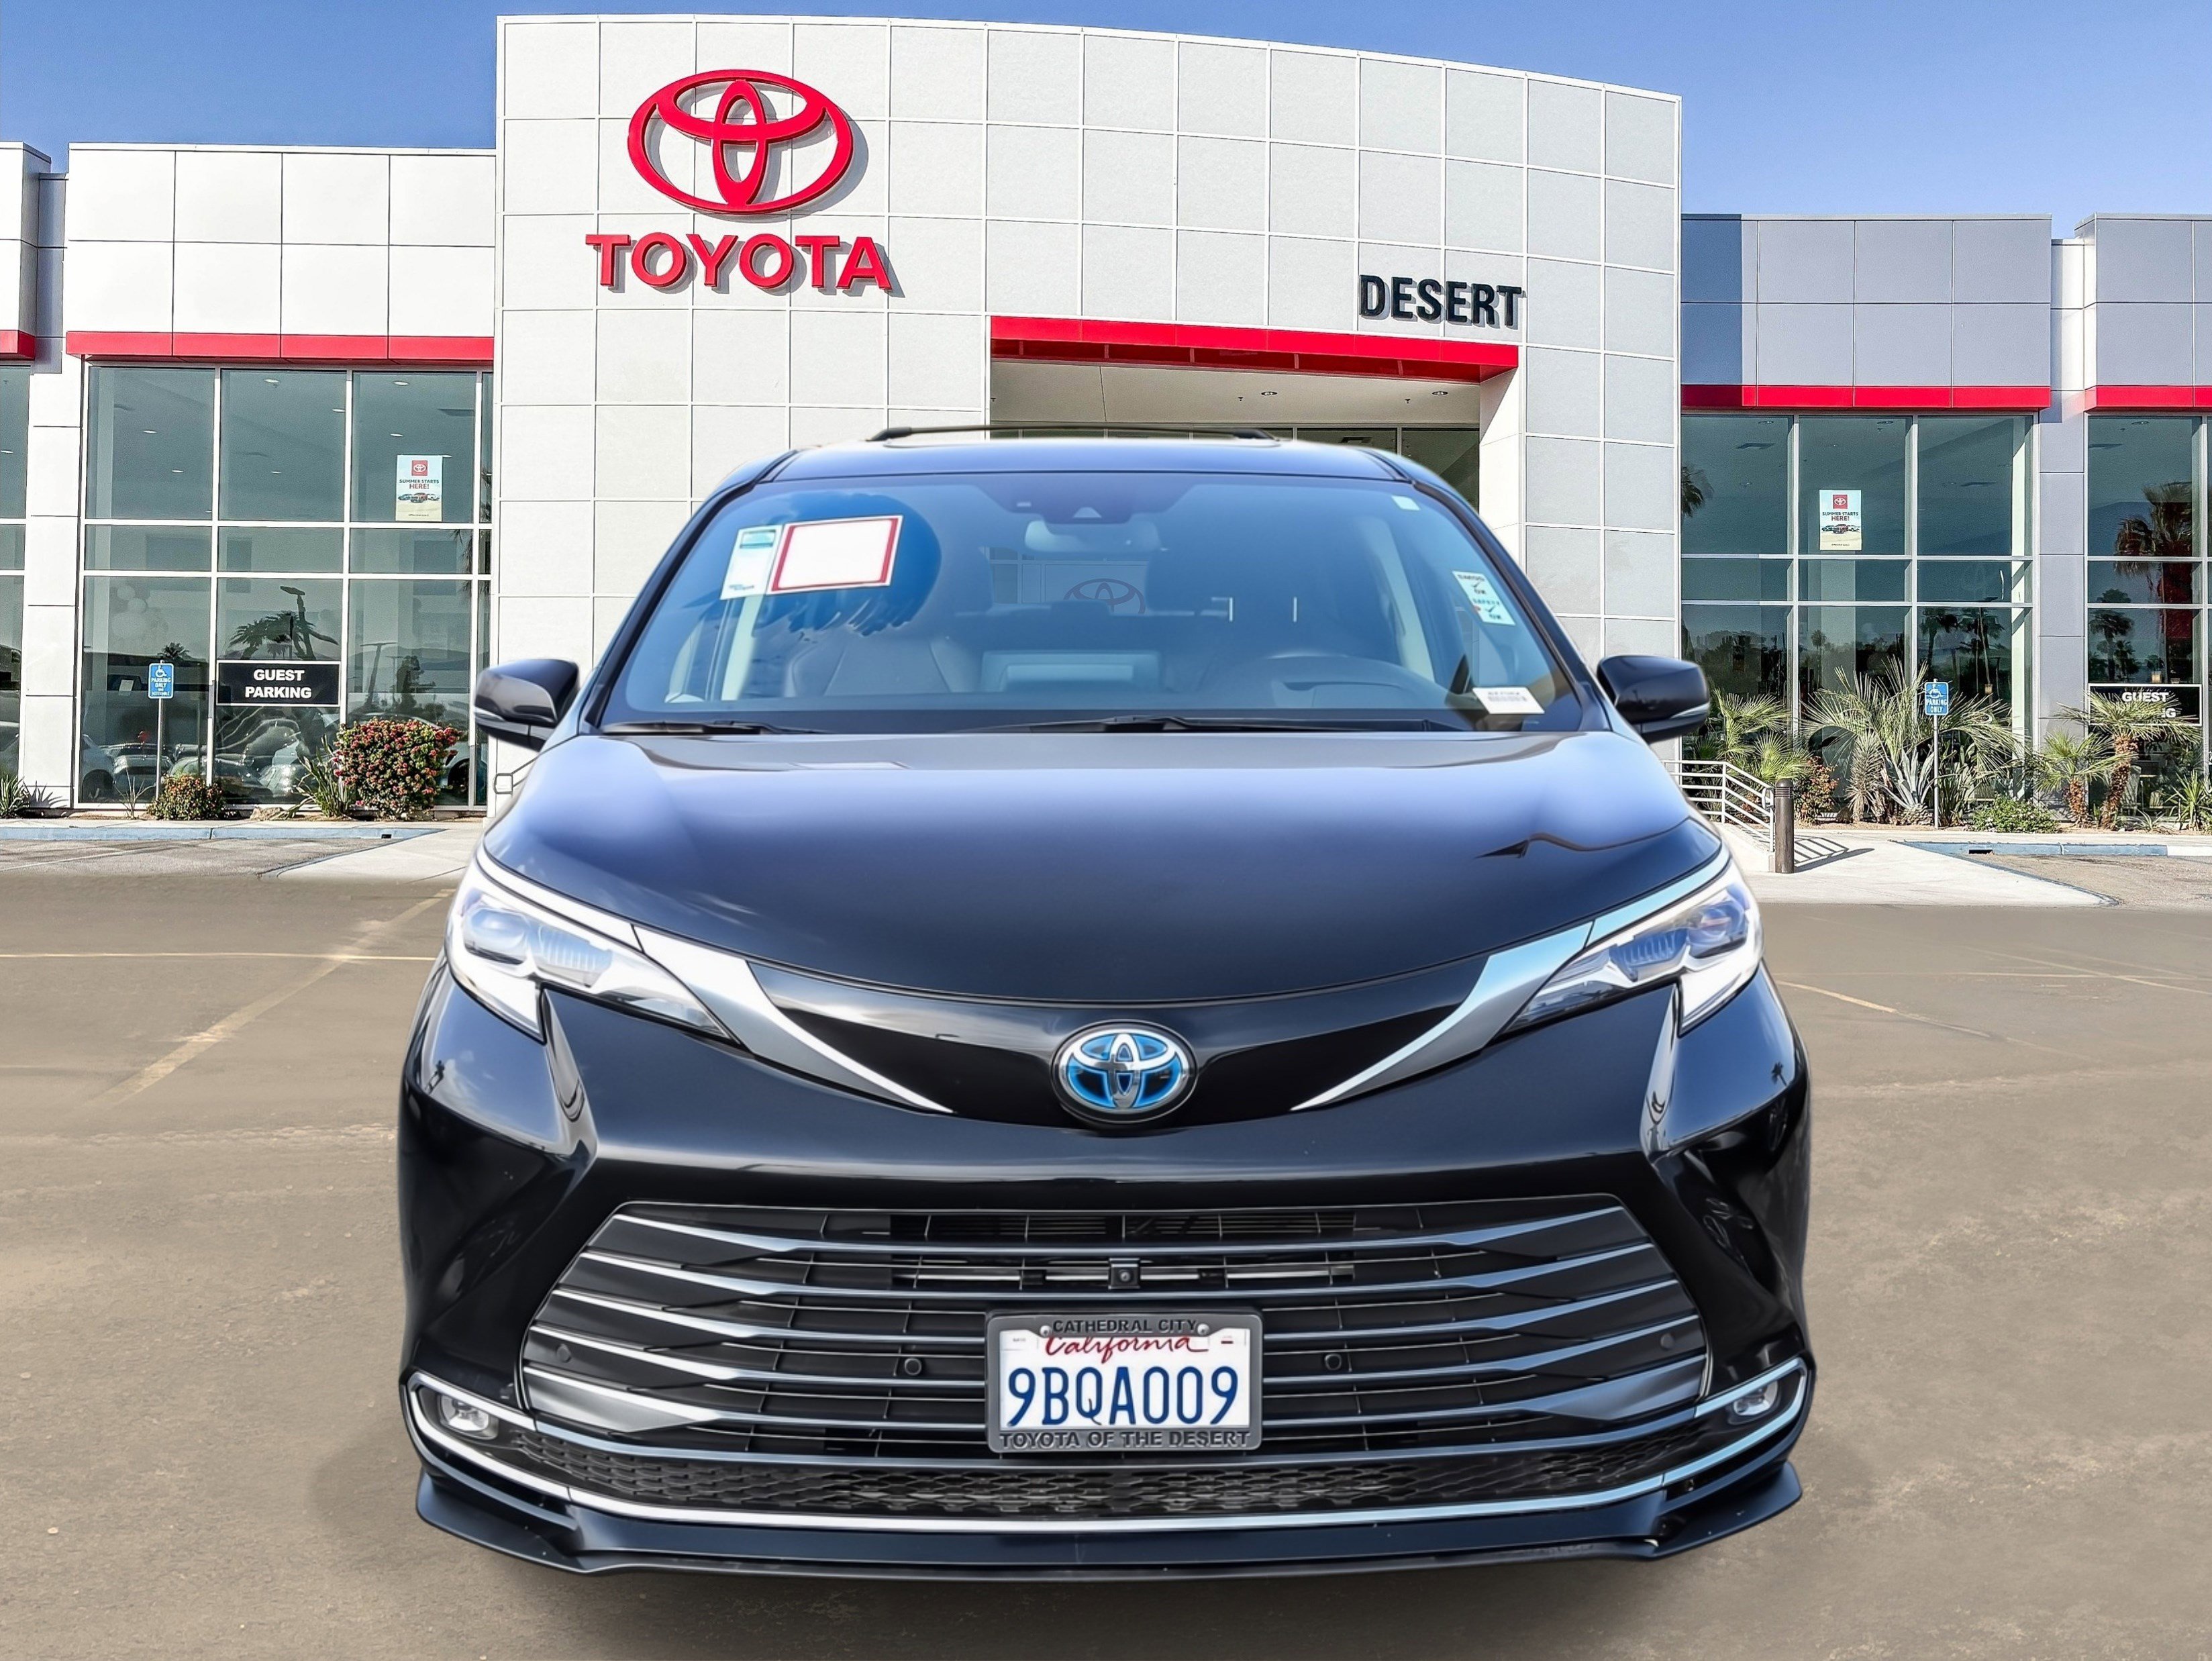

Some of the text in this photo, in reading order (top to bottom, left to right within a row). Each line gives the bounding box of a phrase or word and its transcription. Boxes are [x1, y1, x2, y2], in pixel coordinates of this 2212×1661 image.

[585, 232, 893, 291] TOYOTA
[1359, 274, 1522, 327] DESERT
[253, 668, 305, 681] GUEST
[244, 686, 312, 699] PARKING
[2121, 691, 2170, 703] GUEST
[1052, 1319, 1197, 1333] CATHEDRAL CITY
[1045, 1336, 1209, 1364] California
[1007, 1365, 1239, 1427] 9BQA009
[999, 1429, 1251, 1448] TOYOTA OF THE DESERT
